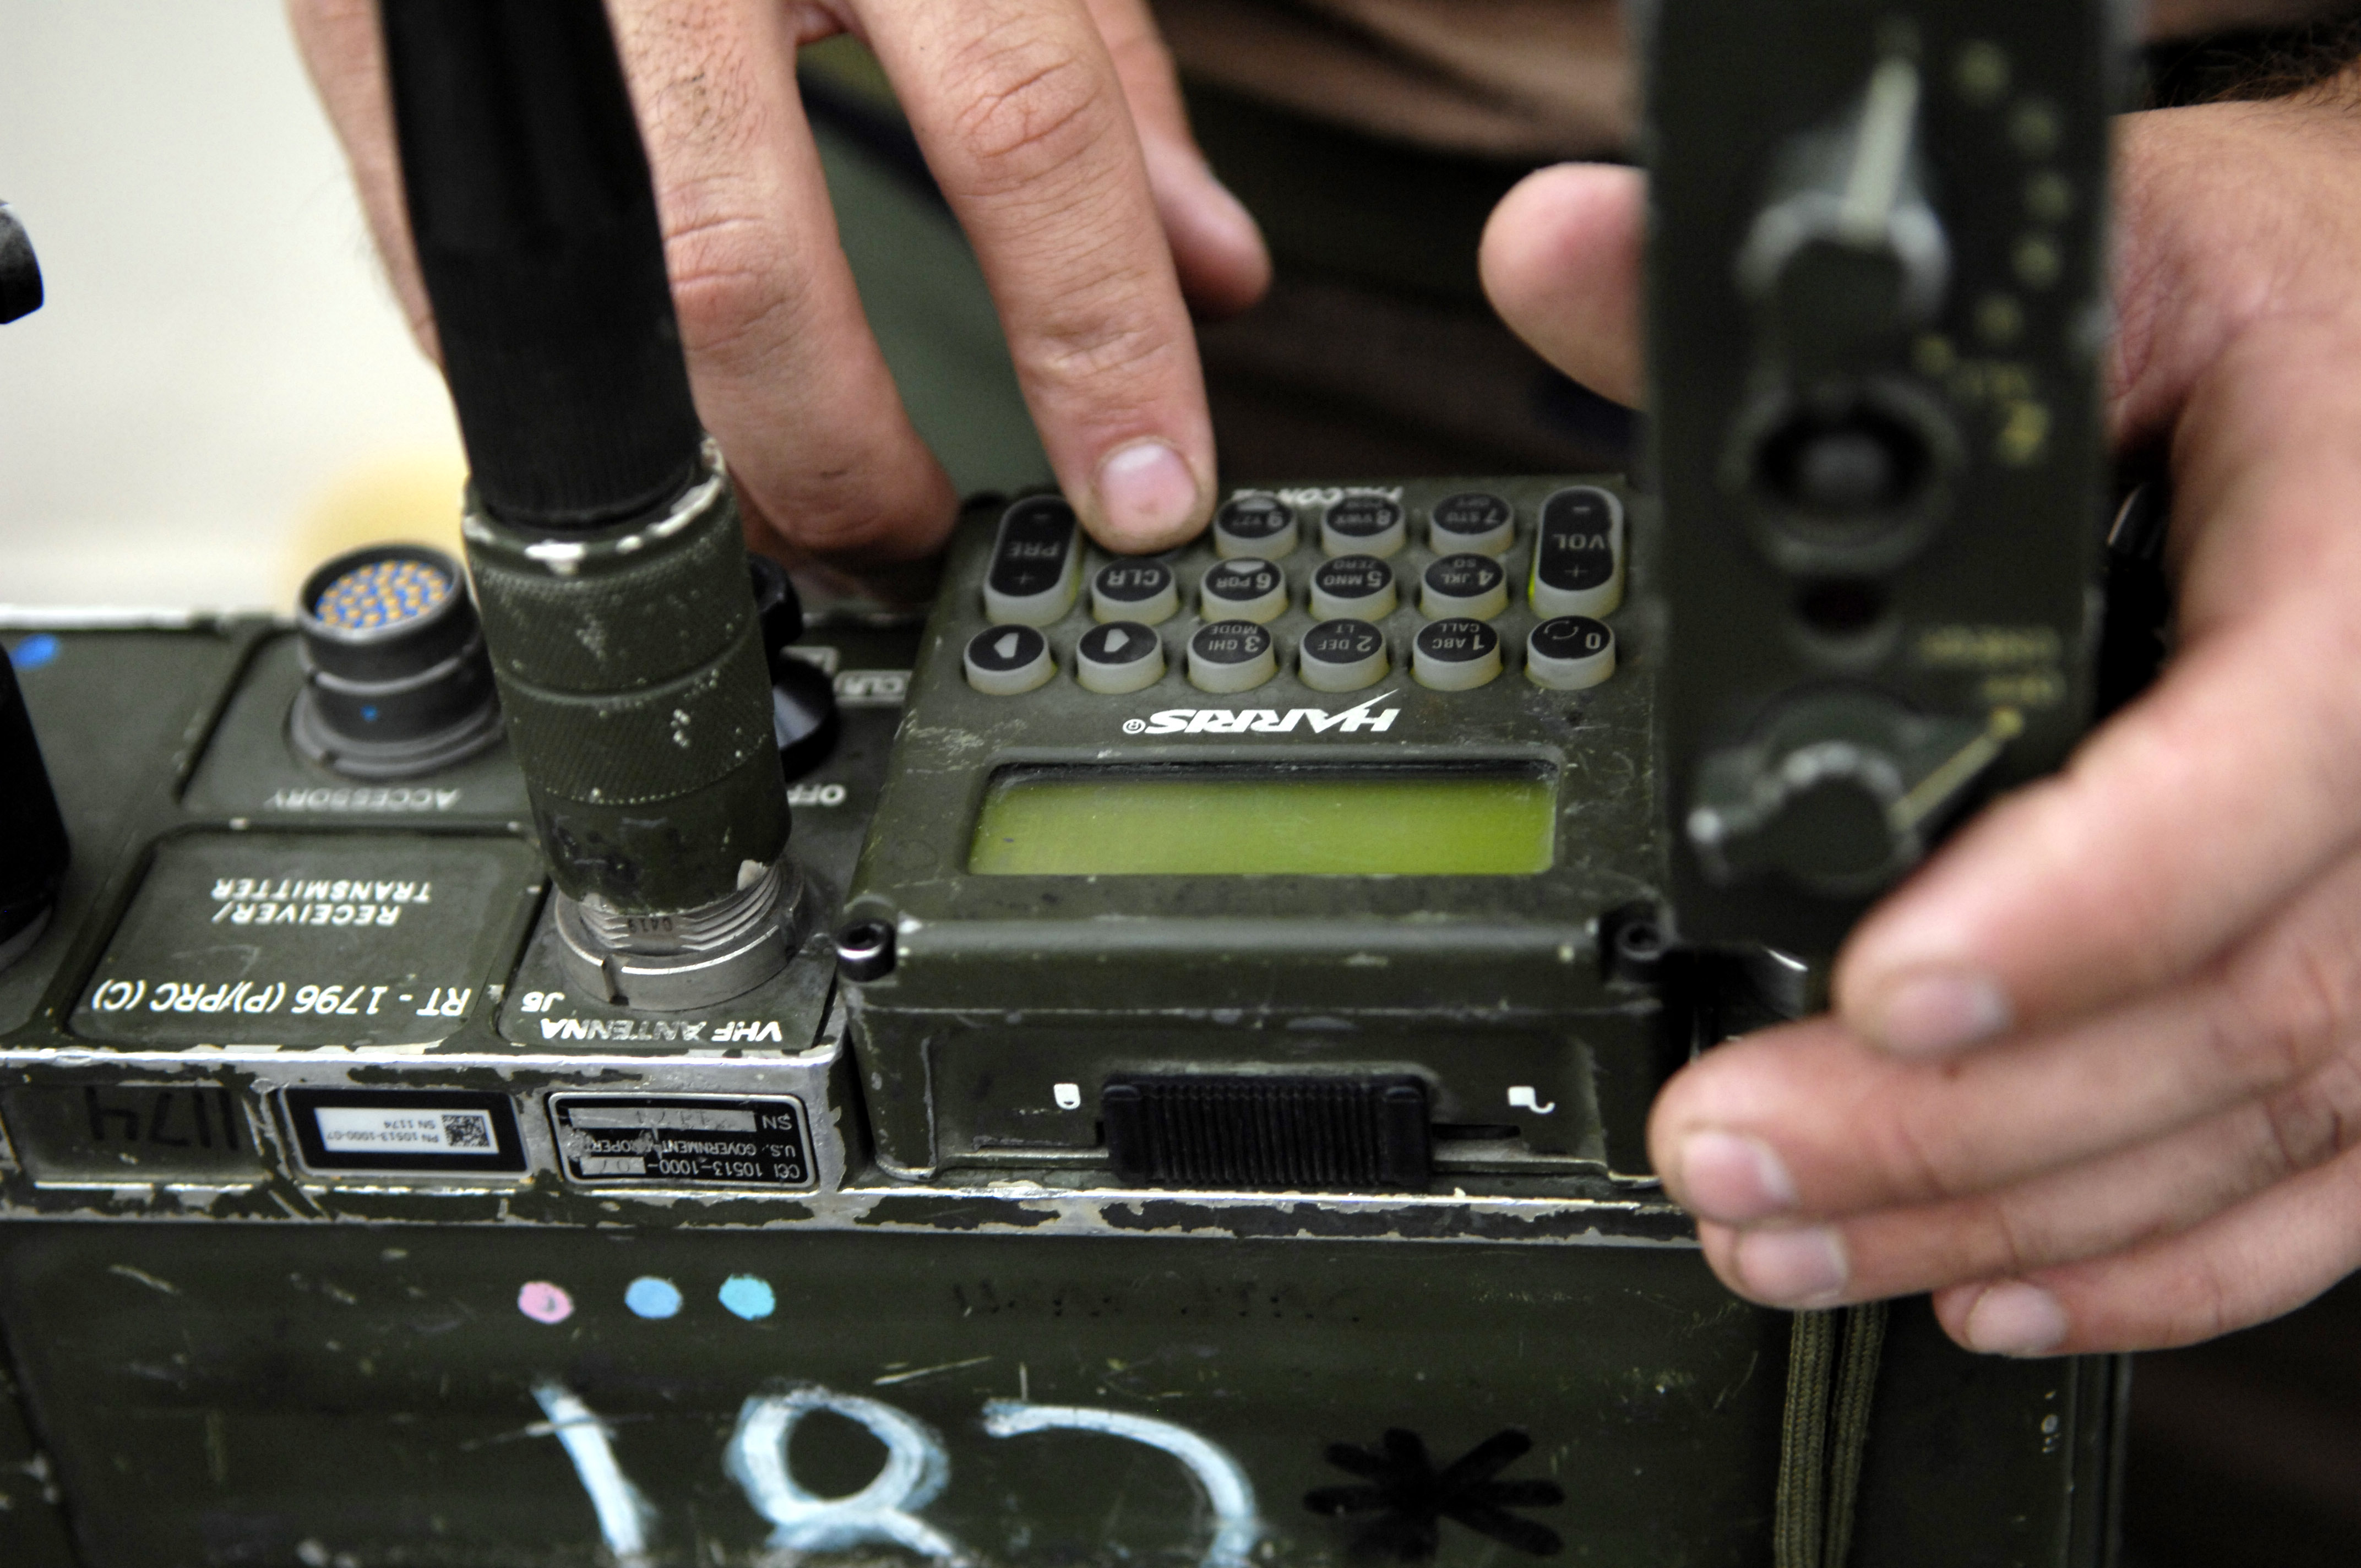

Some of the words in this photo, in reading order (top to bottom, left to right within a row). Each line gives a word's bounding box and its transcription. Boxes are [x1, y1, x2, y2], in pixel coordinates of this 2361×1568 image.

[1265, 511, 1283, 528] 9
[1375, 510, 1391, 526] 8
[1484, 510, 1500, 524] 7
[1006, 540, 1060, 558] PRE
[1552, 533, 1606, 549] VOL
[1332, 559, 1377, 570] ZERO
[1107, 569, 1160, 586] CLR
[1256, 573, 1271, 589] 6
[1324, 574, 1362, 586] MNO
[1367, 571, 1382, 586] 5
[1440, 573, 1470, 584] JKL
[1478, 569, 1494, 585] 4
[1210, 624, 1258, 635] MODE
[1336, 624, 1354, 634] LT
[1439, 623, 1480, 633] CALL
[1209, 639, 1238, 651] GHI
[1245, 636, 1260, 652] 3
[1318, 639, 1350, 651] DEF
[1357, 635, 1373, 651] 2
[1432, 639, 1466, 649] ABC
[1473, 635, 1484, 651] 1
[1586, 633, 1601, 650] 0
[263, 788, 460, 812] ACCESSORY
[210, 879, 432, 902] TRANSMITTER
[211, 901, 400, 926] RECEIVER/
[92, 978, 145, 1011] (C)
[291, 985, 388, 1015] 1796
[417, 987, 471, 1017] RT
[541, 1019, 706, 1041] ANTENNA
[711, 1021, 783, 1042] VHF
[84, 1086, 239, 1151] 1174
[384, 1120, 414, 1129] 1174
[418, 1120, 436, 1129] SN
[762, 1113, 792, 1129] SN
[422, 1134, 439, 1143] PN
[662, 1141, 757, 1156] GOVERNMENT
[765, 1144, 796, 1156] U.S.
